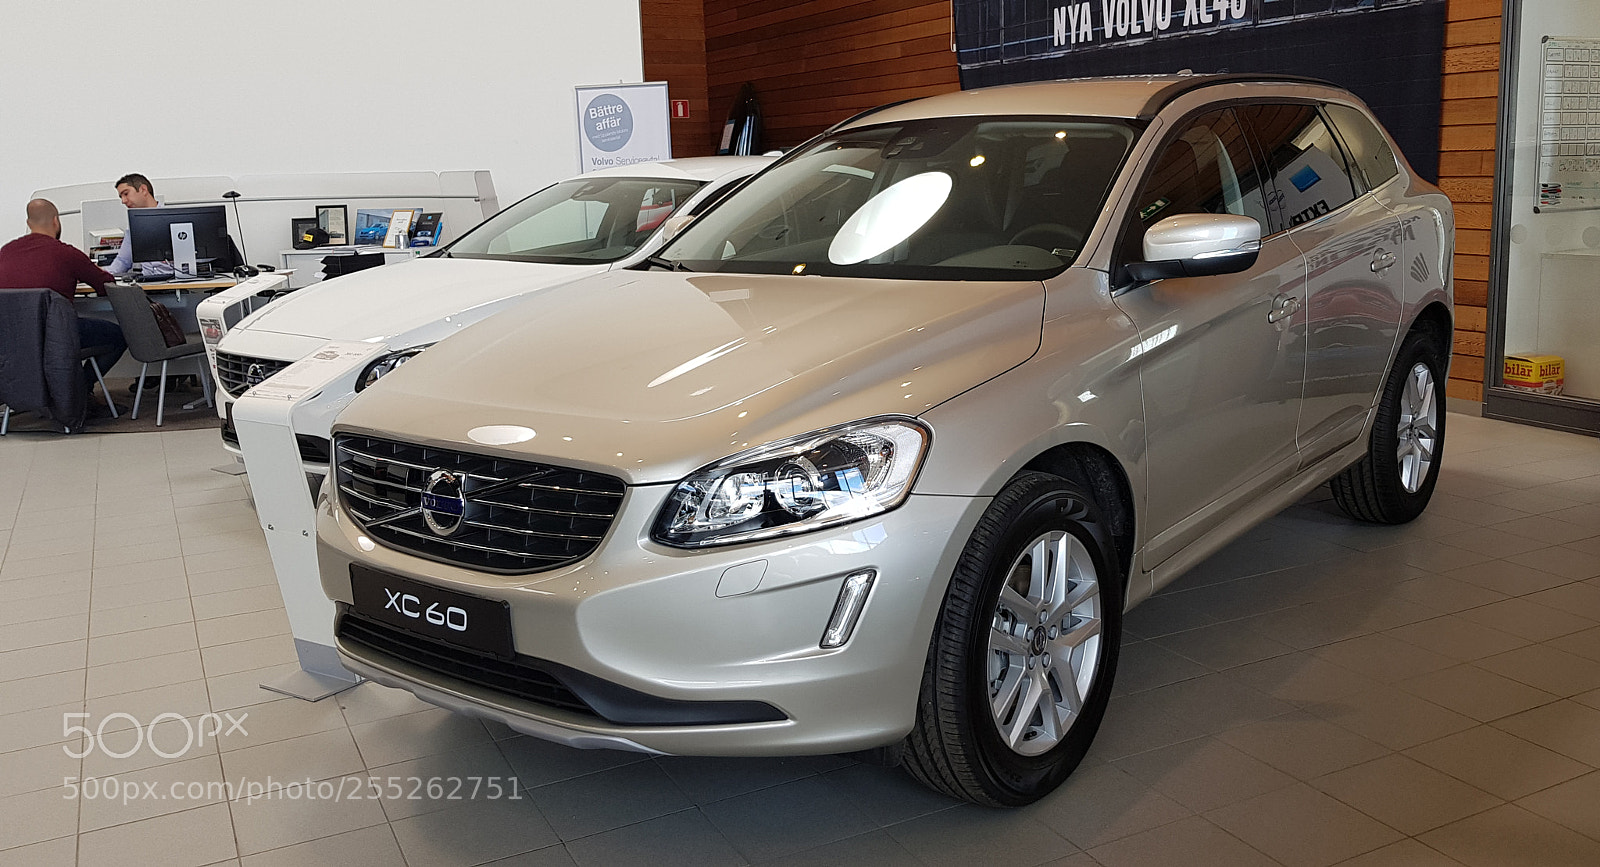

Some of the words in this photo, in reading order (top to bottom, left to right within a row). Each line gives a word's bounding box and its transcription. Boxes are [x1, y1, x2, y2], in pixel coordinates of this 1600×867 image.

[1053, 2, 1093, 47] NYA
[1102, 0, 1171, 39] VOLVO
[589, 104, 624, 119] Bättre
[595, 116, 622, 131] affär
[591, 157, 614, 166] Volvo
[1504, 362, 1533, 378] bilar
[1539, 363, 1561, 378] bilar
